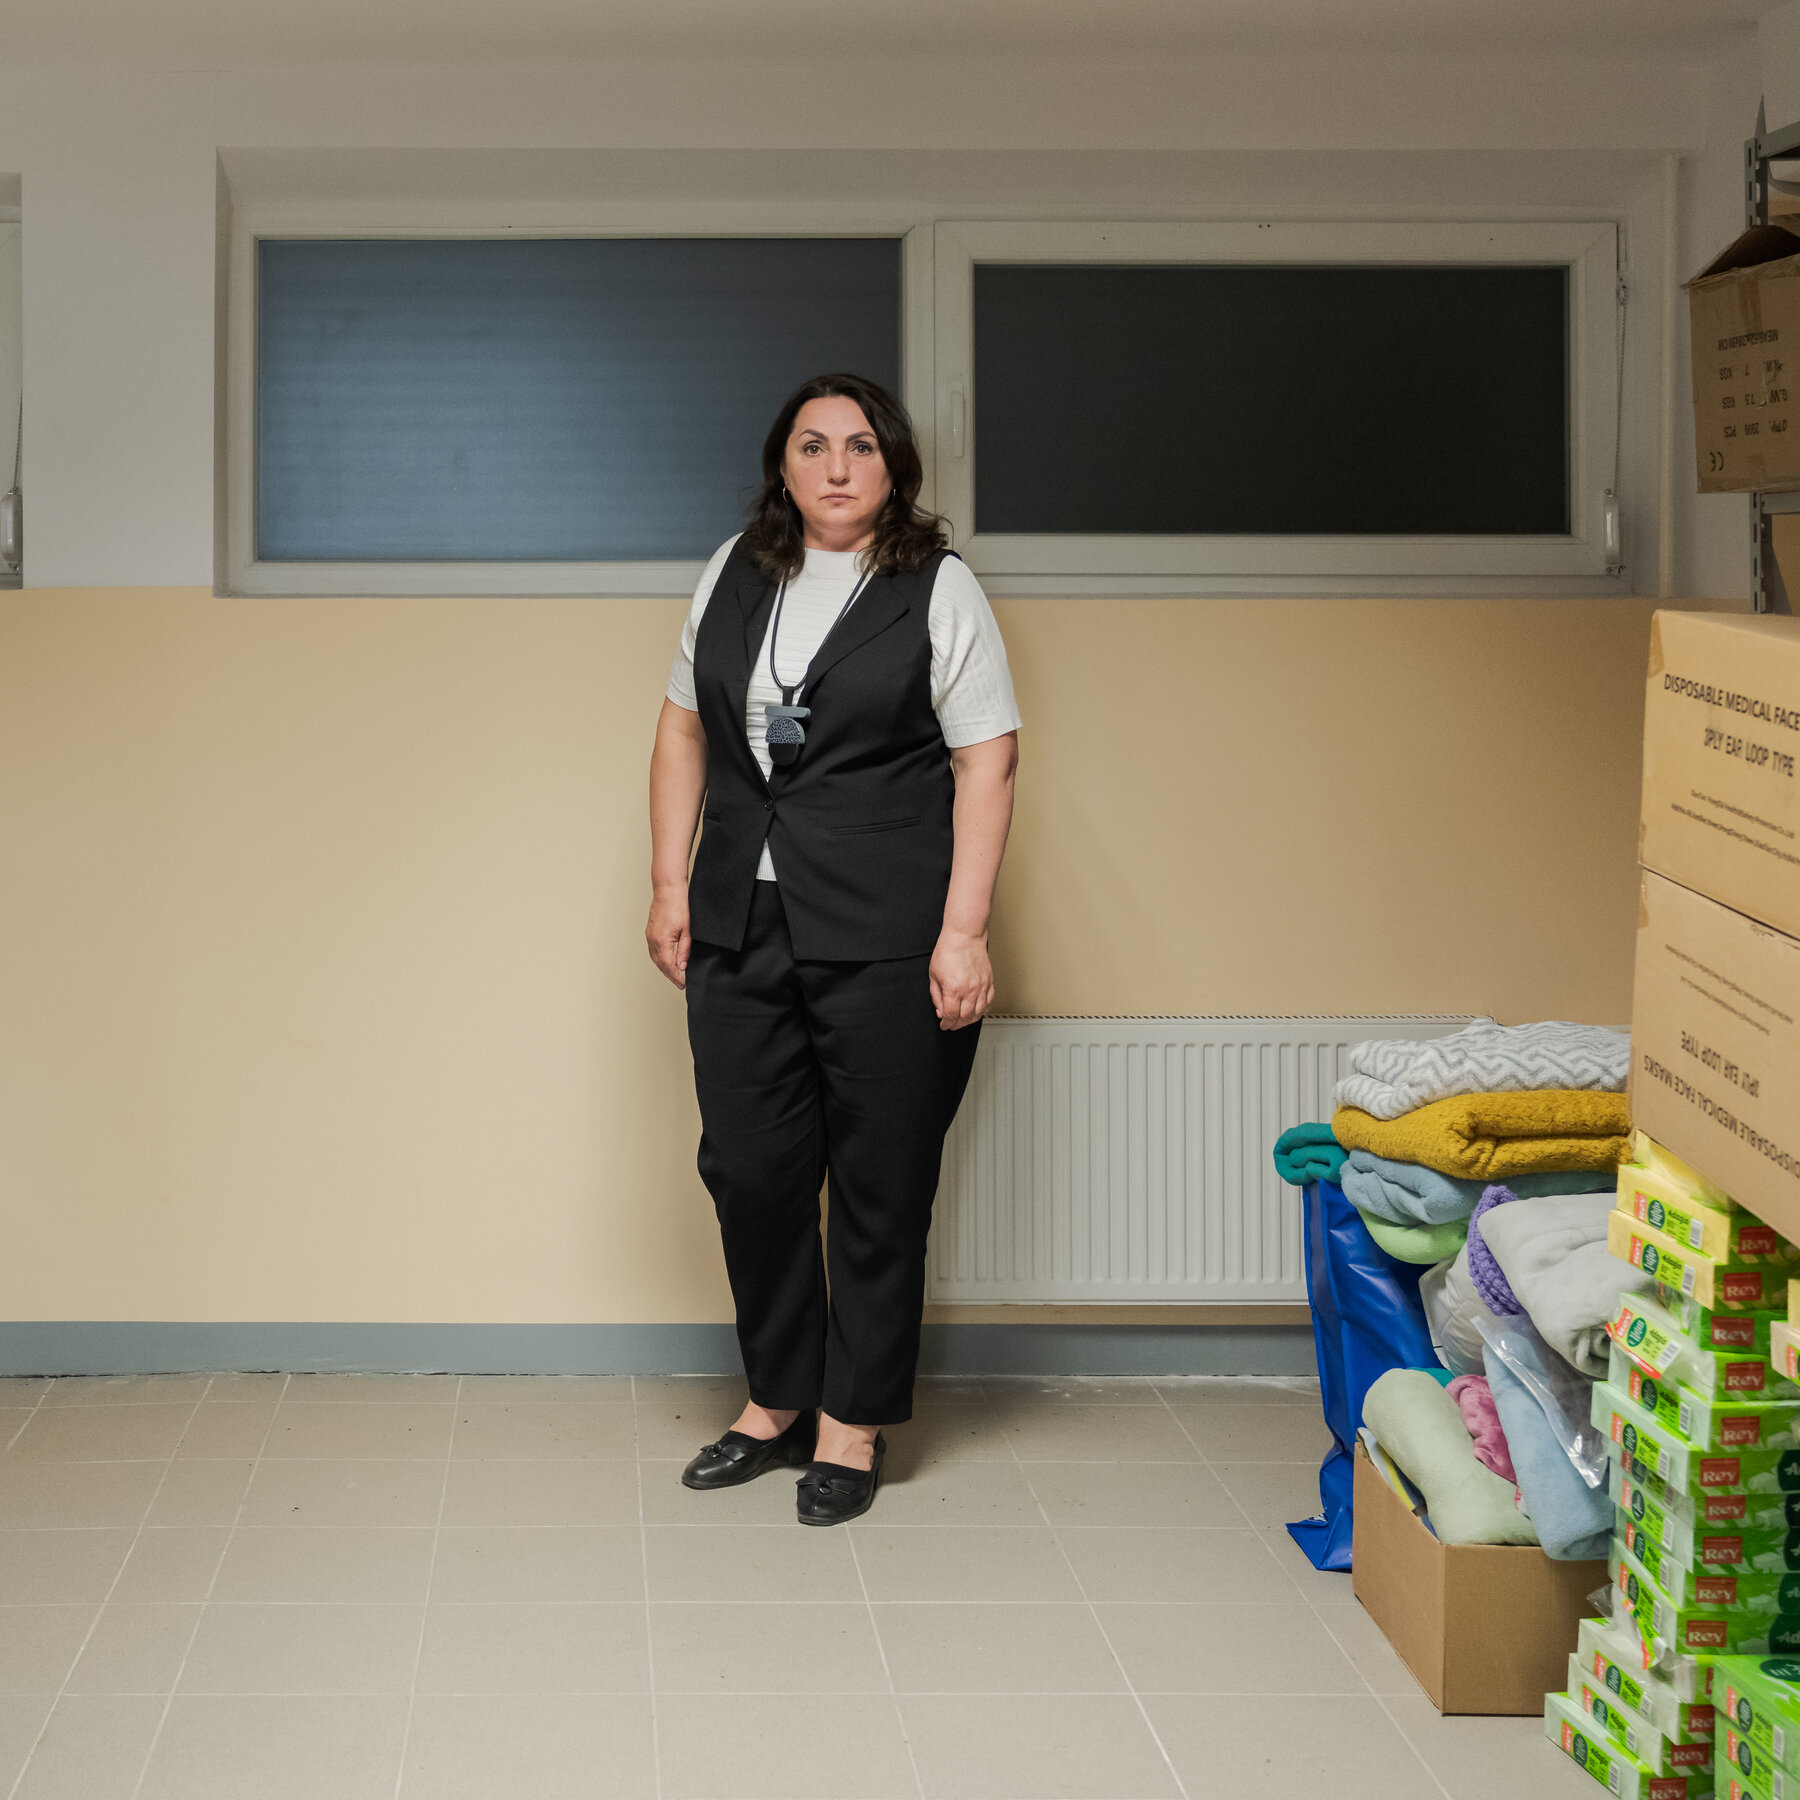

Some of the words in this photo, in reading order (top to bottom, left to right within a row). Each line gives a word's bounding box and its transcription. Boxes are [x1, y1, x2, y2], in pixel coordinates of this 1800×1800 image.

[1664, 673, 1723, 707] DISPOSABLE
[1725, 690, 1771, 723] MEDICAL
[1774, 706, 1800, 731] FACE
[1704, 728, 1723, 751] 3PLY
[1726, 735, 1742, 755] EAR
[1746, 741, 1769, 766] LOOP
[1772, 750, 1794, 777] TYPE
[1681, 1030, 1699, 1059] TYPE
[1702, 1045, 1721, 1074] LOOP
[1644, 1055, 1673, 1089] MASKS
[1724, 1058, 1738, 1086] EAR
[1674, 1075, 1695, 1105] FACE
[1698, 1091, 1737, 1134] MEDICAL
[1740, 1121, 1800, 1179] DISPOSABLE
